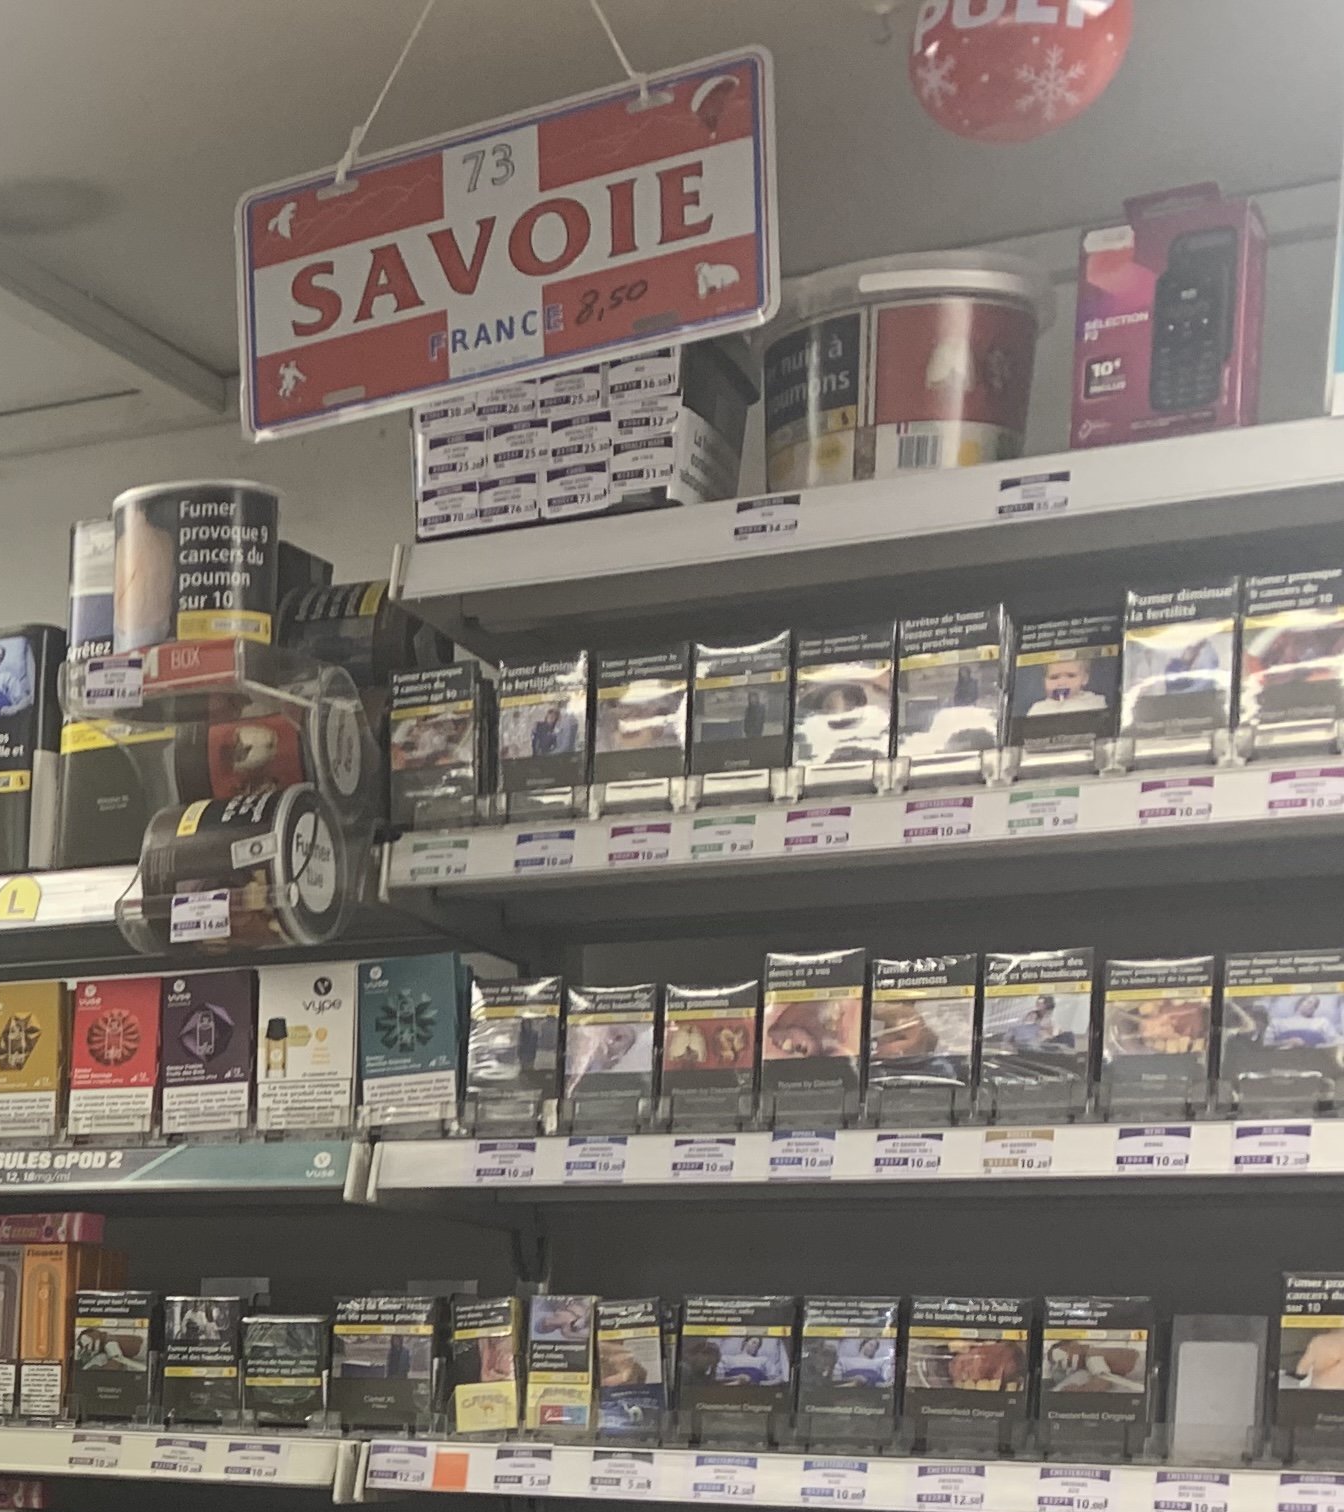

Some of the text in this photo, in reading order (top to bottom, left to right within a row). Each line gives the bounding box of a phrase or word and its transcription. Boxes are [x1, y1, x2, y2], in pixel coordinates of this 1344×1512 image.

[462, 144, 515, 193] 73
[290, 160, 714, 337] SAVOIE
[429, 303, 565, 361] FRANCE
[179, 500, 238, 518] Fumer
[179, 523, 258, 543] provoque
[179, 545, 264, 566] cancers du
[179, 569, 251, 590] poumon
[178, 590, 234, 610] sur 10
[1143, 604, 1197, 620] fertilité
[171, 647, 201, 669] BOX
[8, 891, 25, 914] L
[302, 998, 342, 1015] vype
[53, 1151, 106, 1170] ePOD
[108, 1150, 123, 1166] 2
